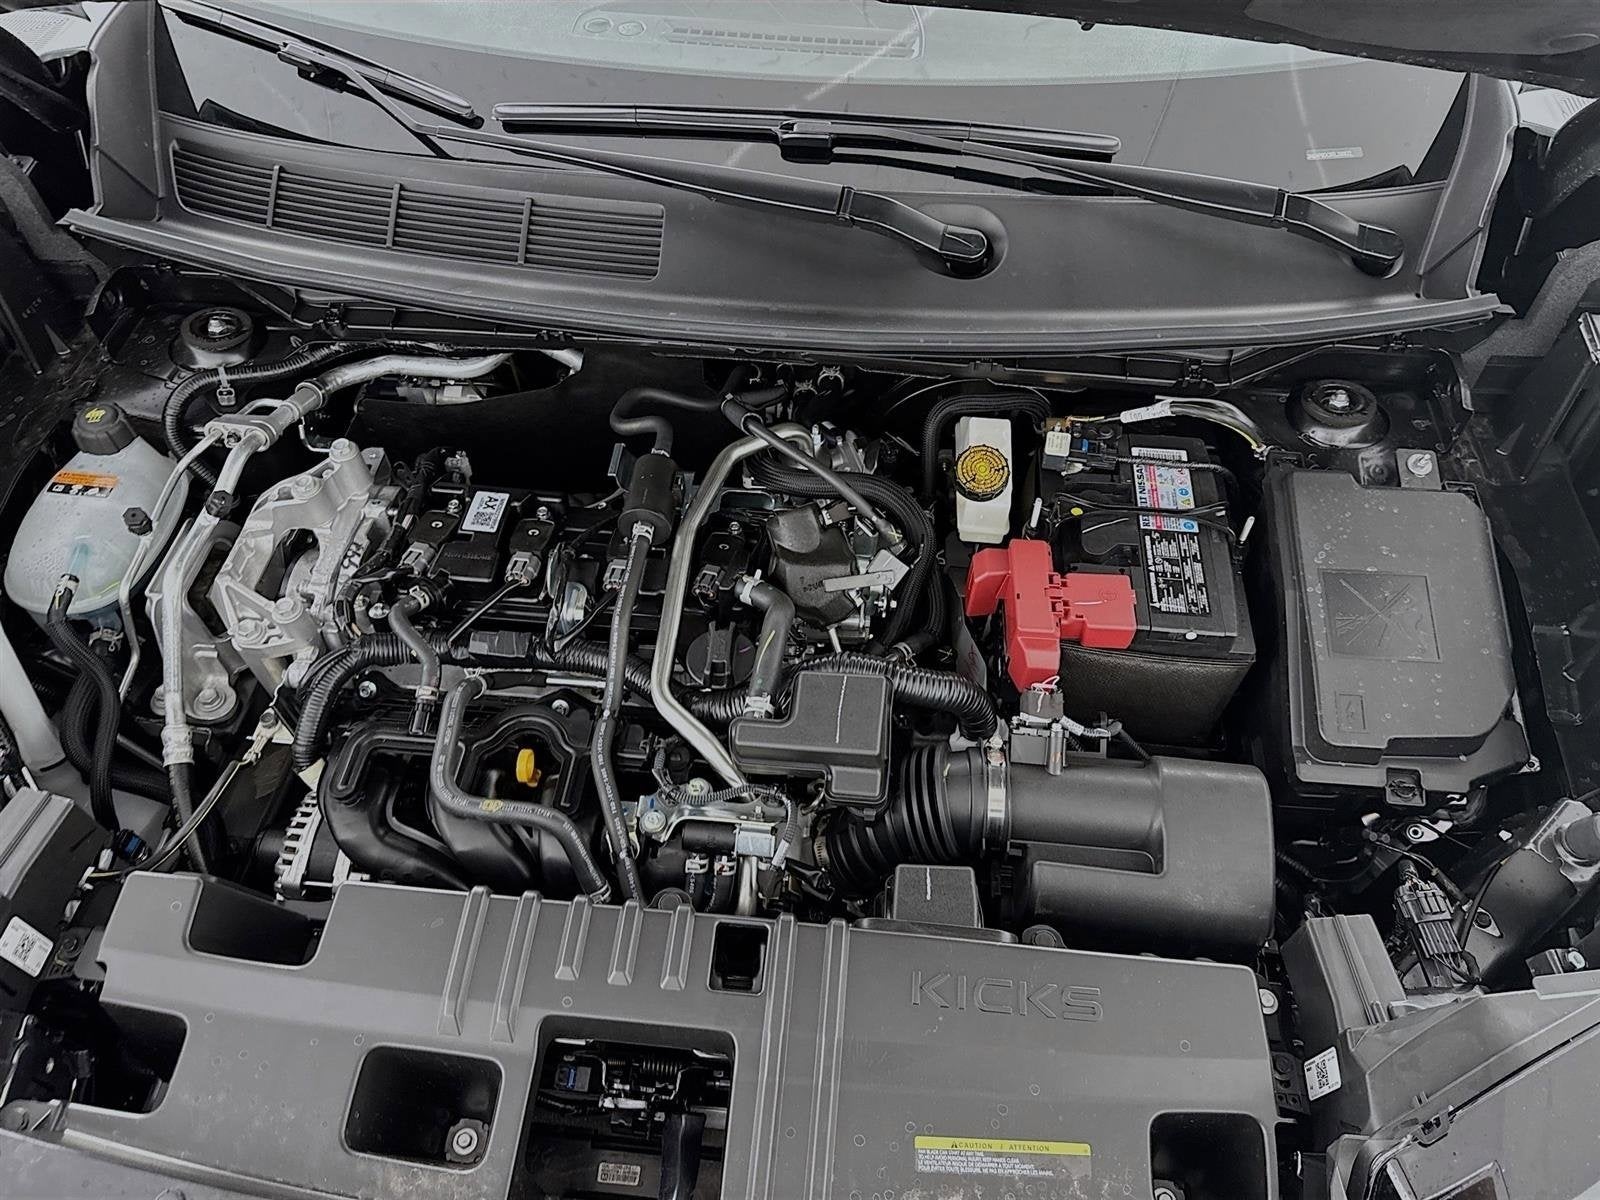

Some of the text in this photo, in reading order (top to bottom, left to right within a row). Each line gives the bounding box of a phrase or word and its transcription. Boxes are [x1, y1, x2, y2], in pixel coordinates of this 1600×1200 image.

[1135, 463, 1147, 495] NISSA
[911, 970, 1104, 1022] KICKS
[959, 1142, 992, 1150] CAUTION
[1009, 1143, 1050, 1152] ATTENTION
